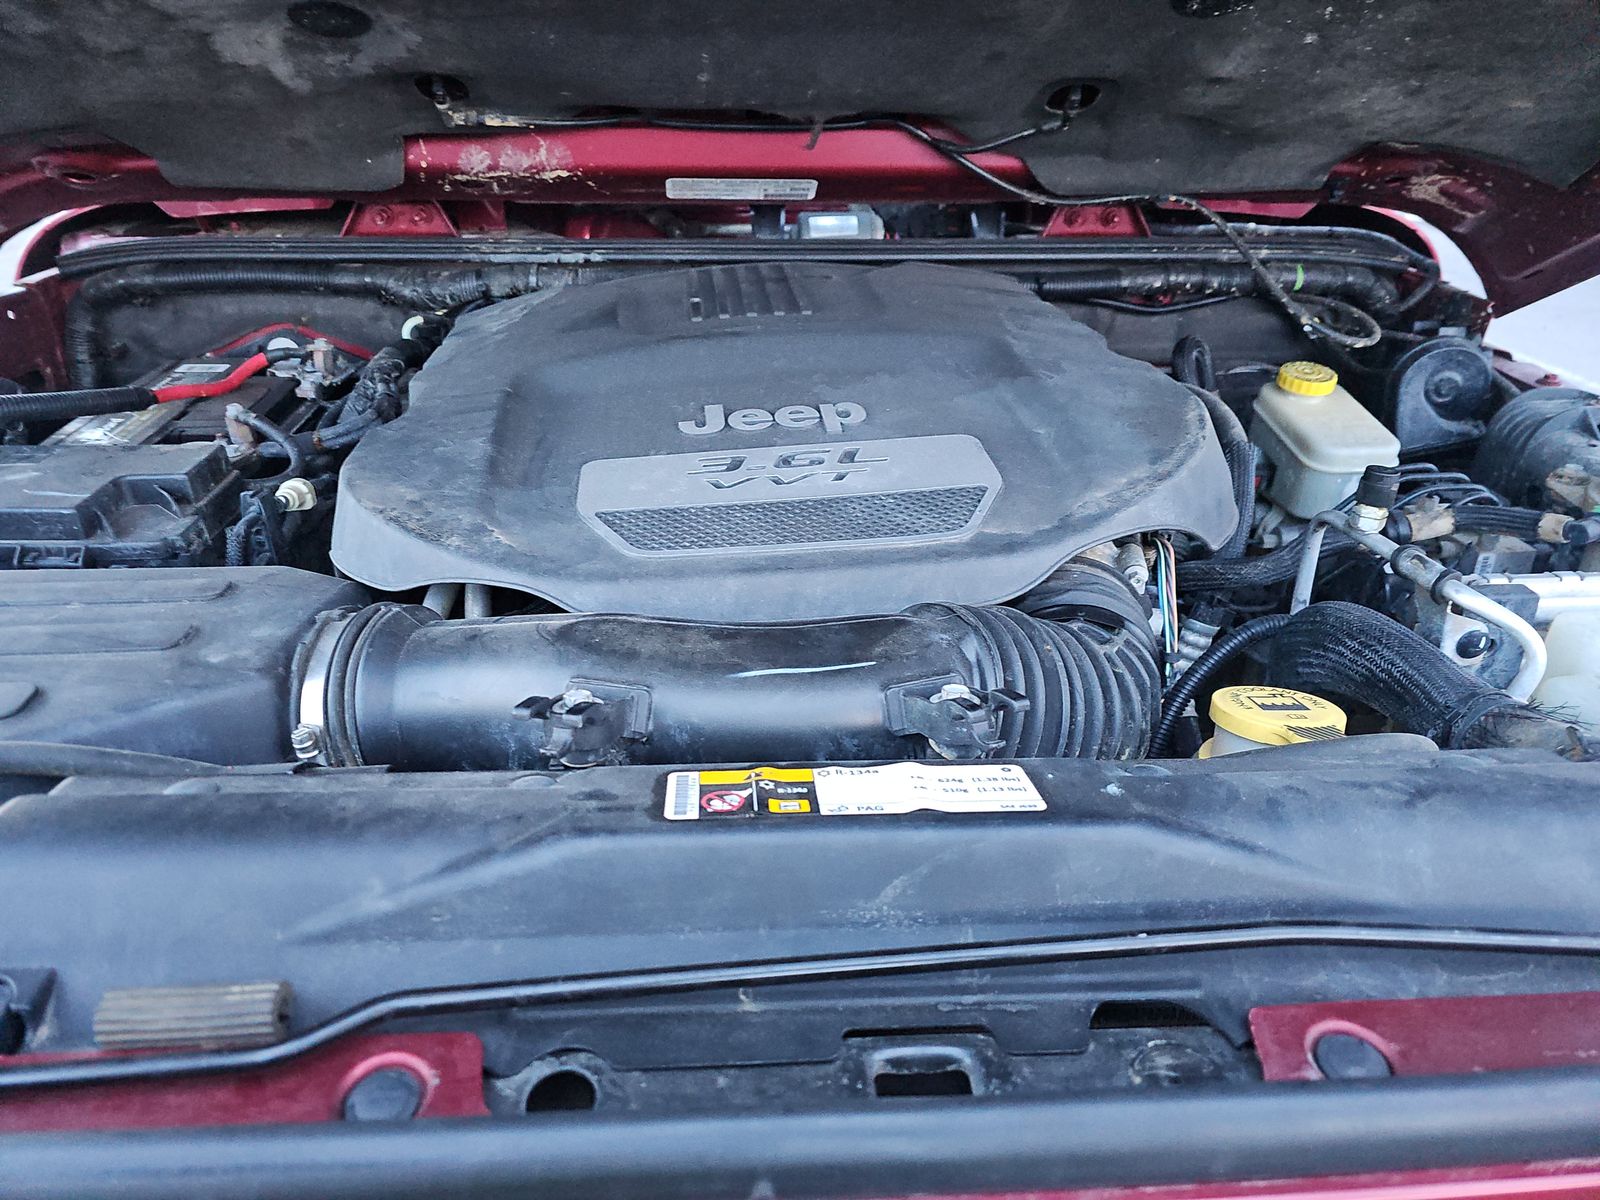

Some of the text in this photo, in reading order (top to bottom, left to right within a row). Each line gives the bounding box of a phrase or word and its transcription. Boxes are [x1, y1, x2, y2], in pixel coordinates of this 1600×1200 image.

[678, 402, 867, 436] Jeep
[687, 447, 889, 475] 3.6L
[703, 468, 869, 490] VVT
